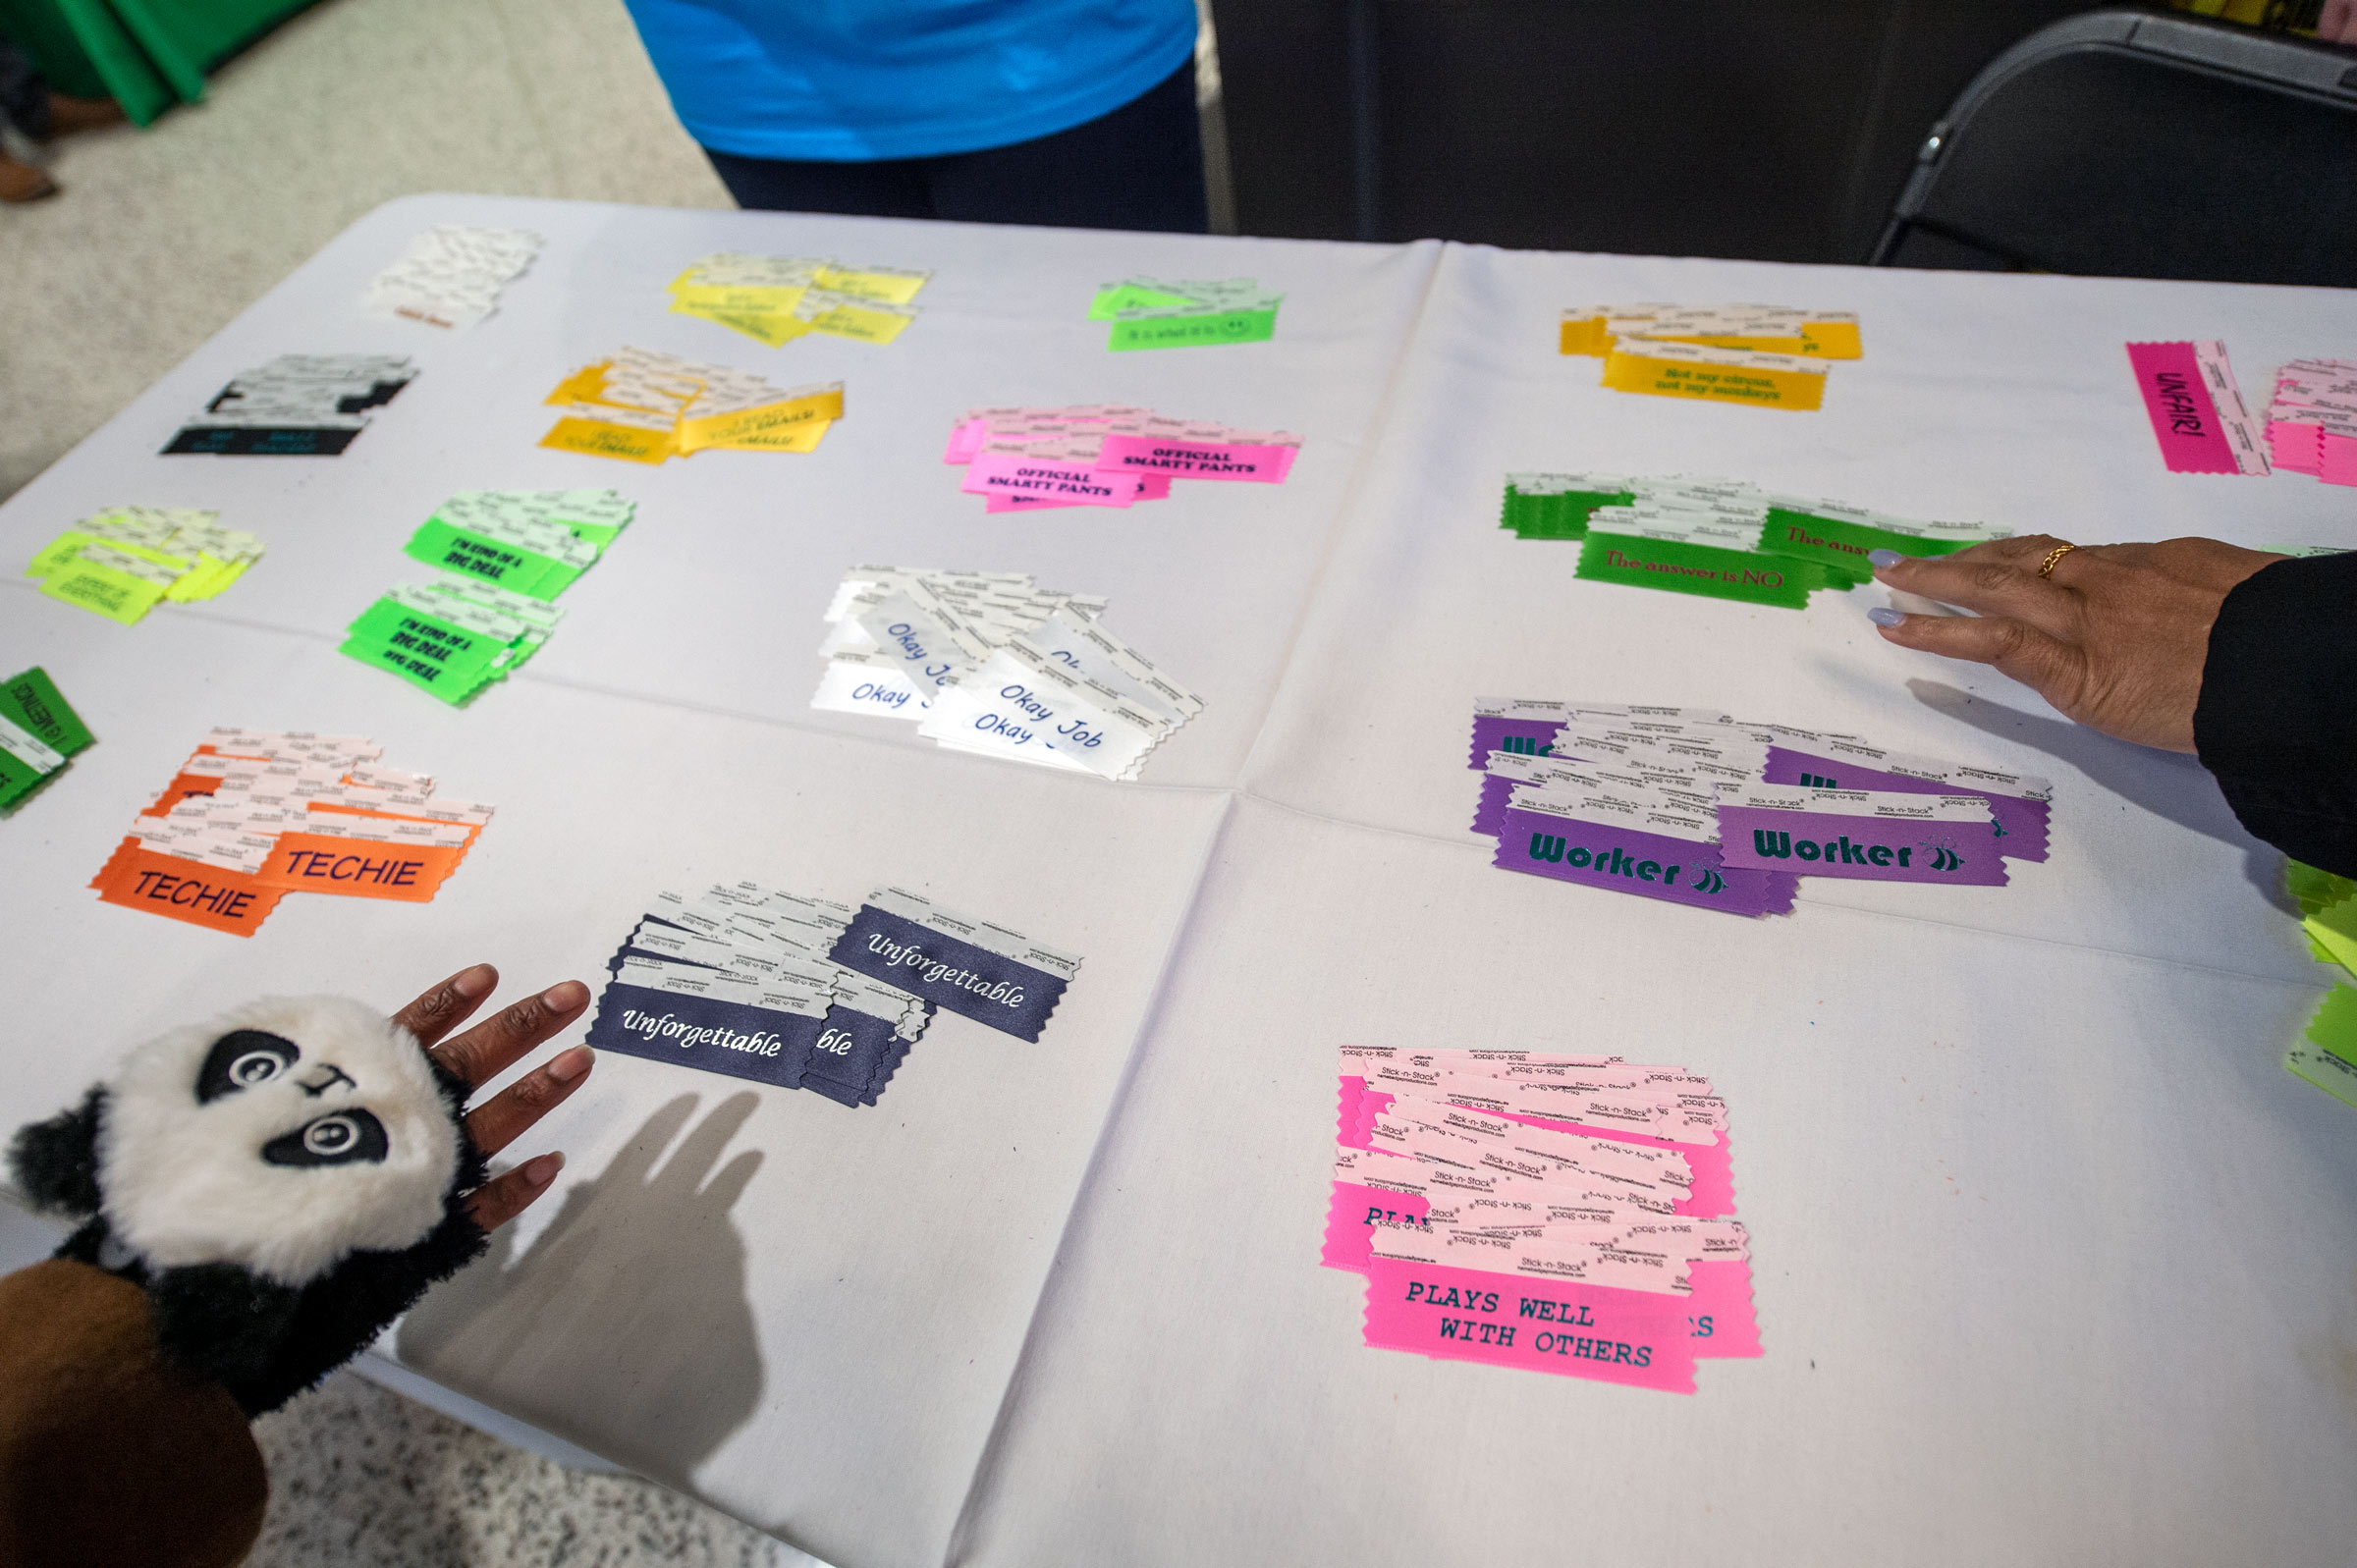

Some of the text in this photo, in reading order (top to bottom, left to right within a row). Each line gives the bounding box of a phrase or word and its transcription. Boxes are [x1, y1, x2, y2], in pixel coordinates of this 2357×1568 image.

[1666, 369, 1690, 379] Not
[1696, 372, 1718, 382] my
[1685, 383, 1707, 393] my
[2157, 372, 2206, 437] UNFAIR!
[1124, 456, 1257, 473] SMARTY PANTS
[1153, 448, 1232, 460] OFFICIAL
[988, 476, 1113, 497] SMARTY PANTS
[1016, 468, 1090, 483] OFFICIAL
[1787, 526, 1824, 546] The
[445, 552, 505, 579] BIG DEAL
[469, 543, 498, 559] KIND
[498, 552, 515, 564] OF
[1606, 550, 1783, 588] The answer is NO
[390, 631, 453, 663] BIG DEAL
[417, 623, 447, 641] KIND
[446, 634, 462, 646] OF
[888, 622, 929, 661] Okay
[406, 657, 441, 681] DEAL
[852, 682, 910, 709] Okay
[974, 713, 1033, 745] Okay
[1000, 684, 1102, 748] Okay Job
[1528, 832, 1680, 886] Worker
[1753, 830, 1912, 867] Worker
[285, 850, 424, 887] TECHIE
[134, 871, 255, 919] TECHIE
[868, 932, 1024, 1008] Unforgettable
[623, 1008, 782, 1058] Unforgettable
[1405, 1282, 1595, 1327] PLAYS WELL
[1440, 1318, 1653, 1368] WITH OTHERS
